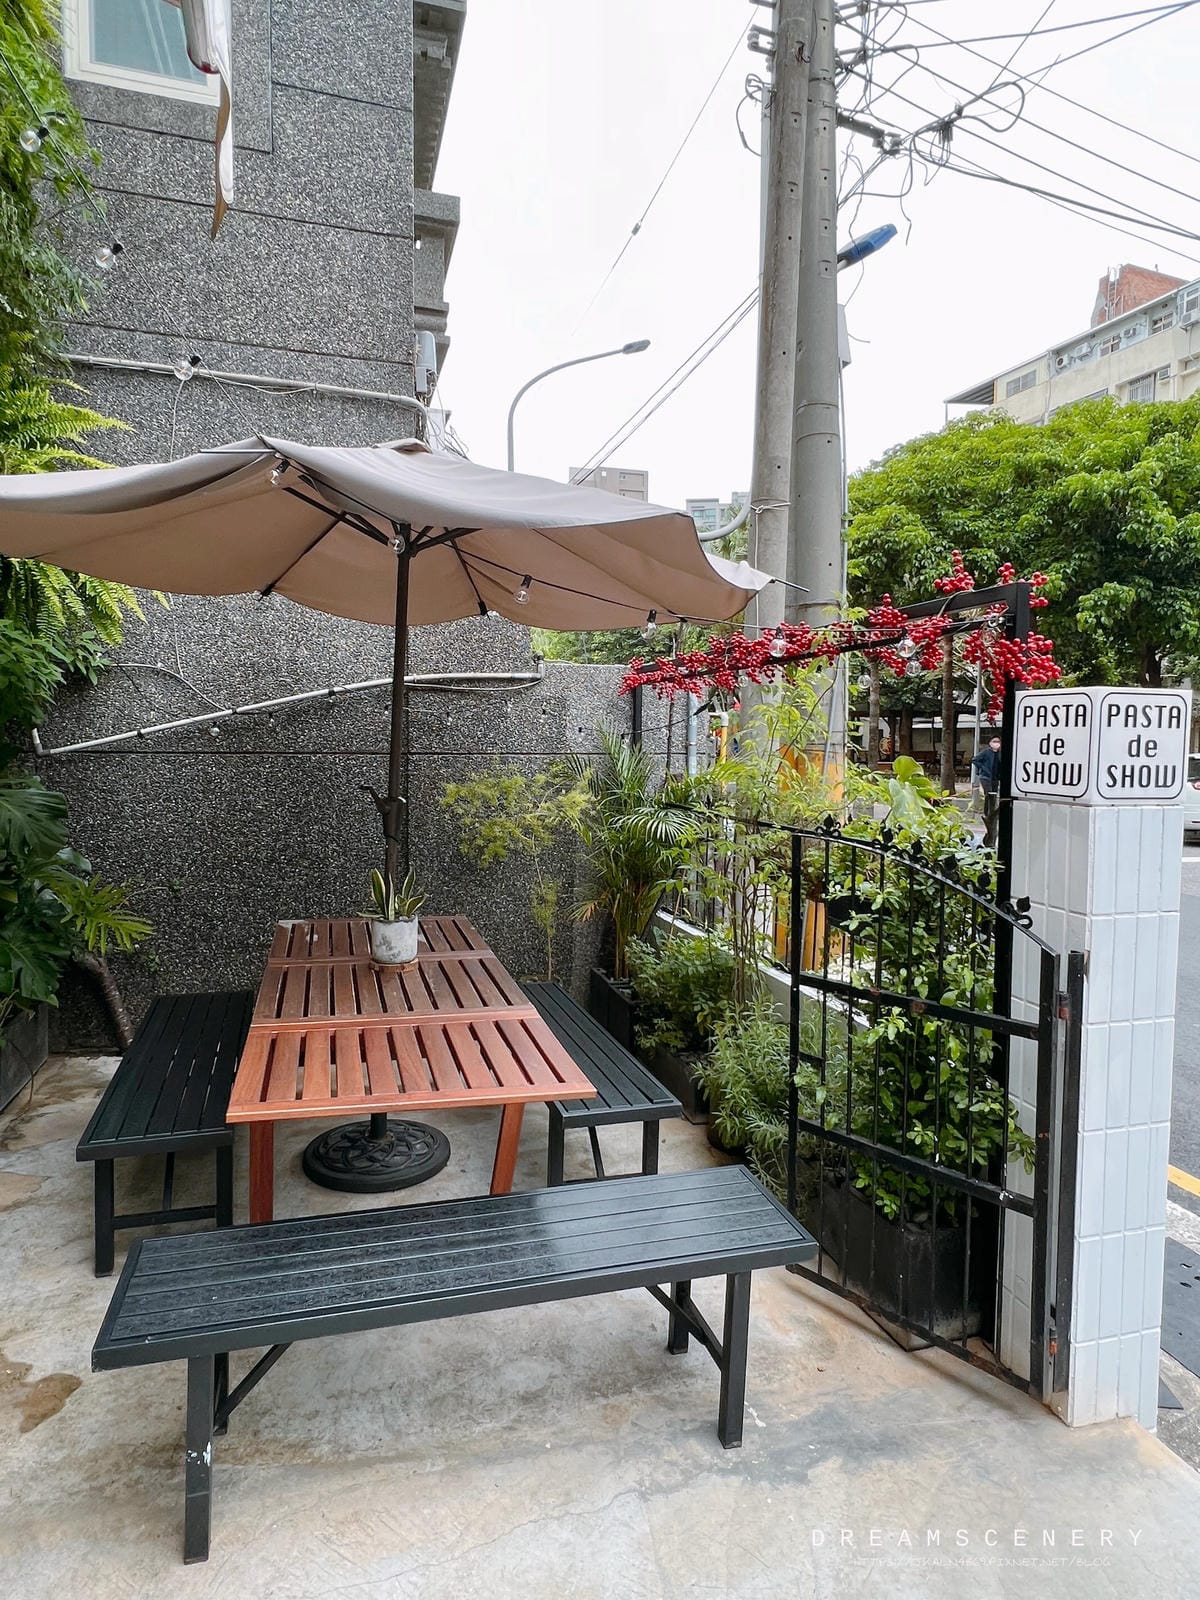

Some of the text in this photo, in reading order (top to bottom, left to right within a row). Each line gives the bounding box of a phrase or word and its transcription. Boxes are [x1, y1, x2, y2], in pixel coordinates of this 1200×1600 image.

[1022, 704, 1087, 728] PASTA
[1107, 703, 1182, 729] PASTA
[1039, 733, 1065, 756] de
[1127, 734, 1158, 758] de
[1021, 761, 1083, 787] SHOW
[1106, 764, 1177, 788] SHOW
